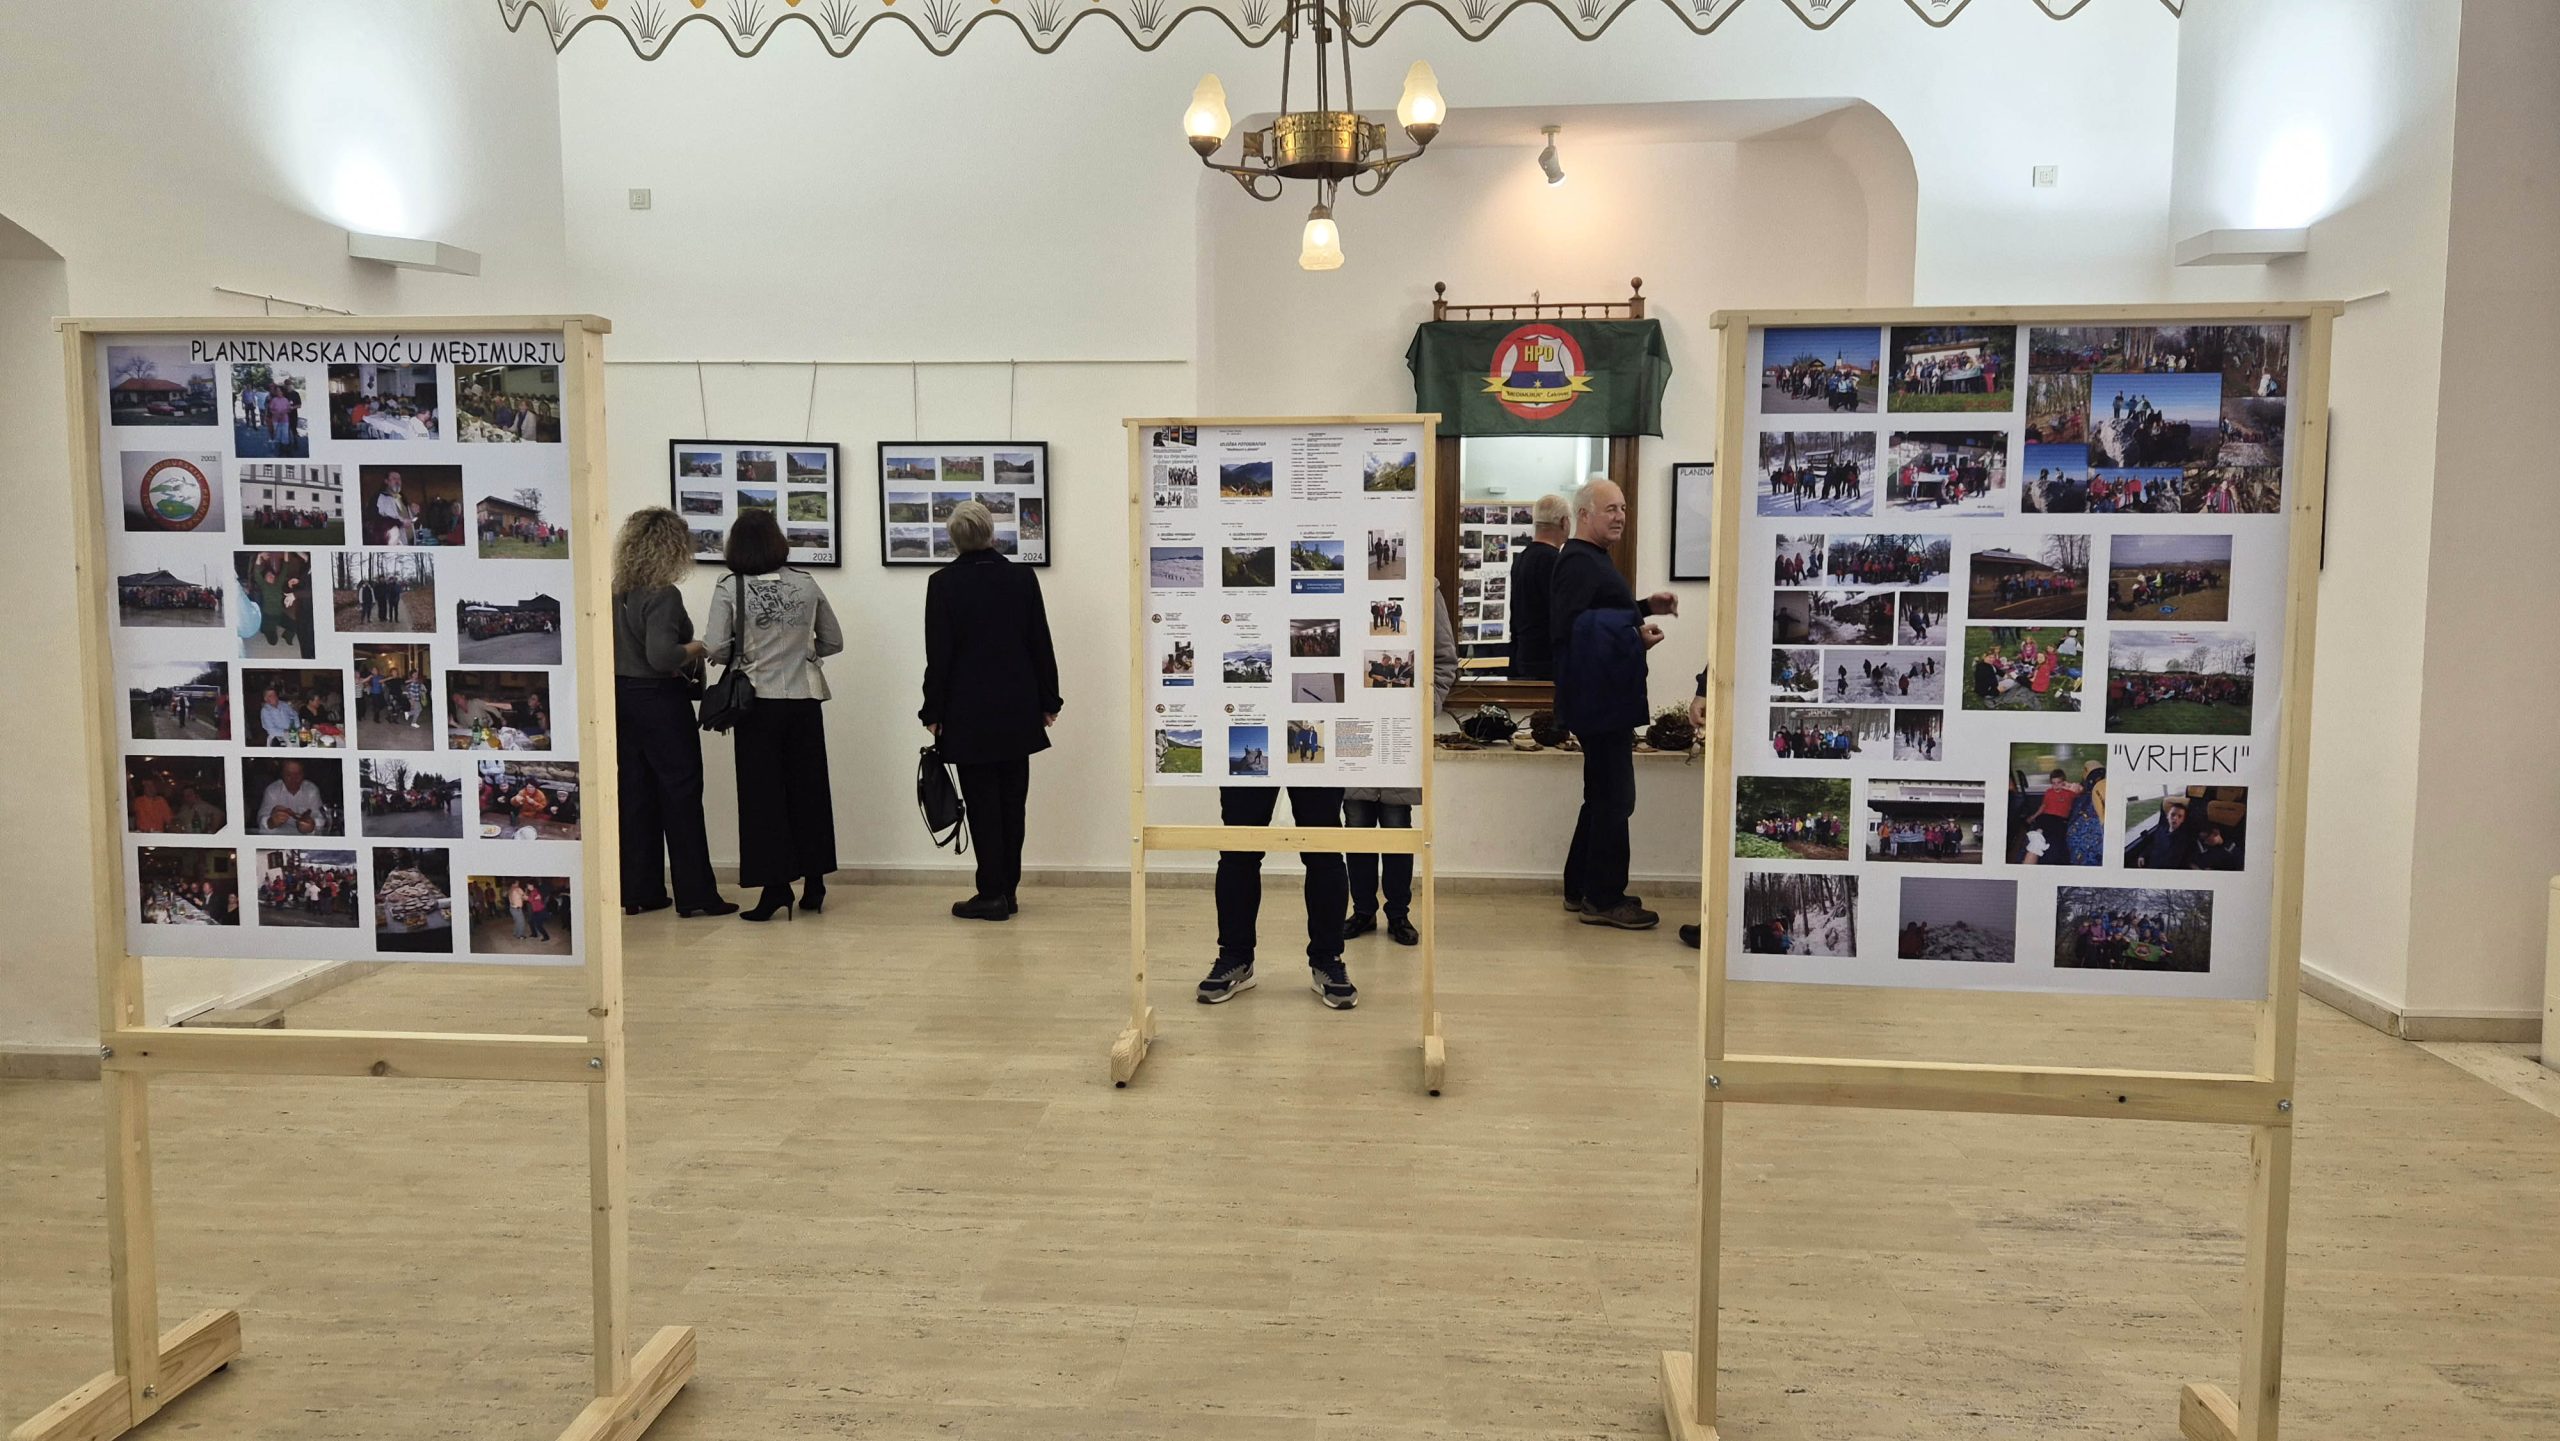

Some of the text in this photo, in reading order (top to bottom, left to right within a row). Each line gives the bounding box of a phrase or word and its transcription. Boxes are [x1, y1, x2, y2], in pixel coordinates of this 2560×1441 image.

[190, 334, 565, 363] PLANINARSKA NOĆ U MEĐIMURJU
[1524, 345, 1554, 362] HPD
[812, 553, 833, 561] 2023
[1023, 552, 1043, 561] 2024
[2114, 744, 2250, 774] "VRHEKI"
